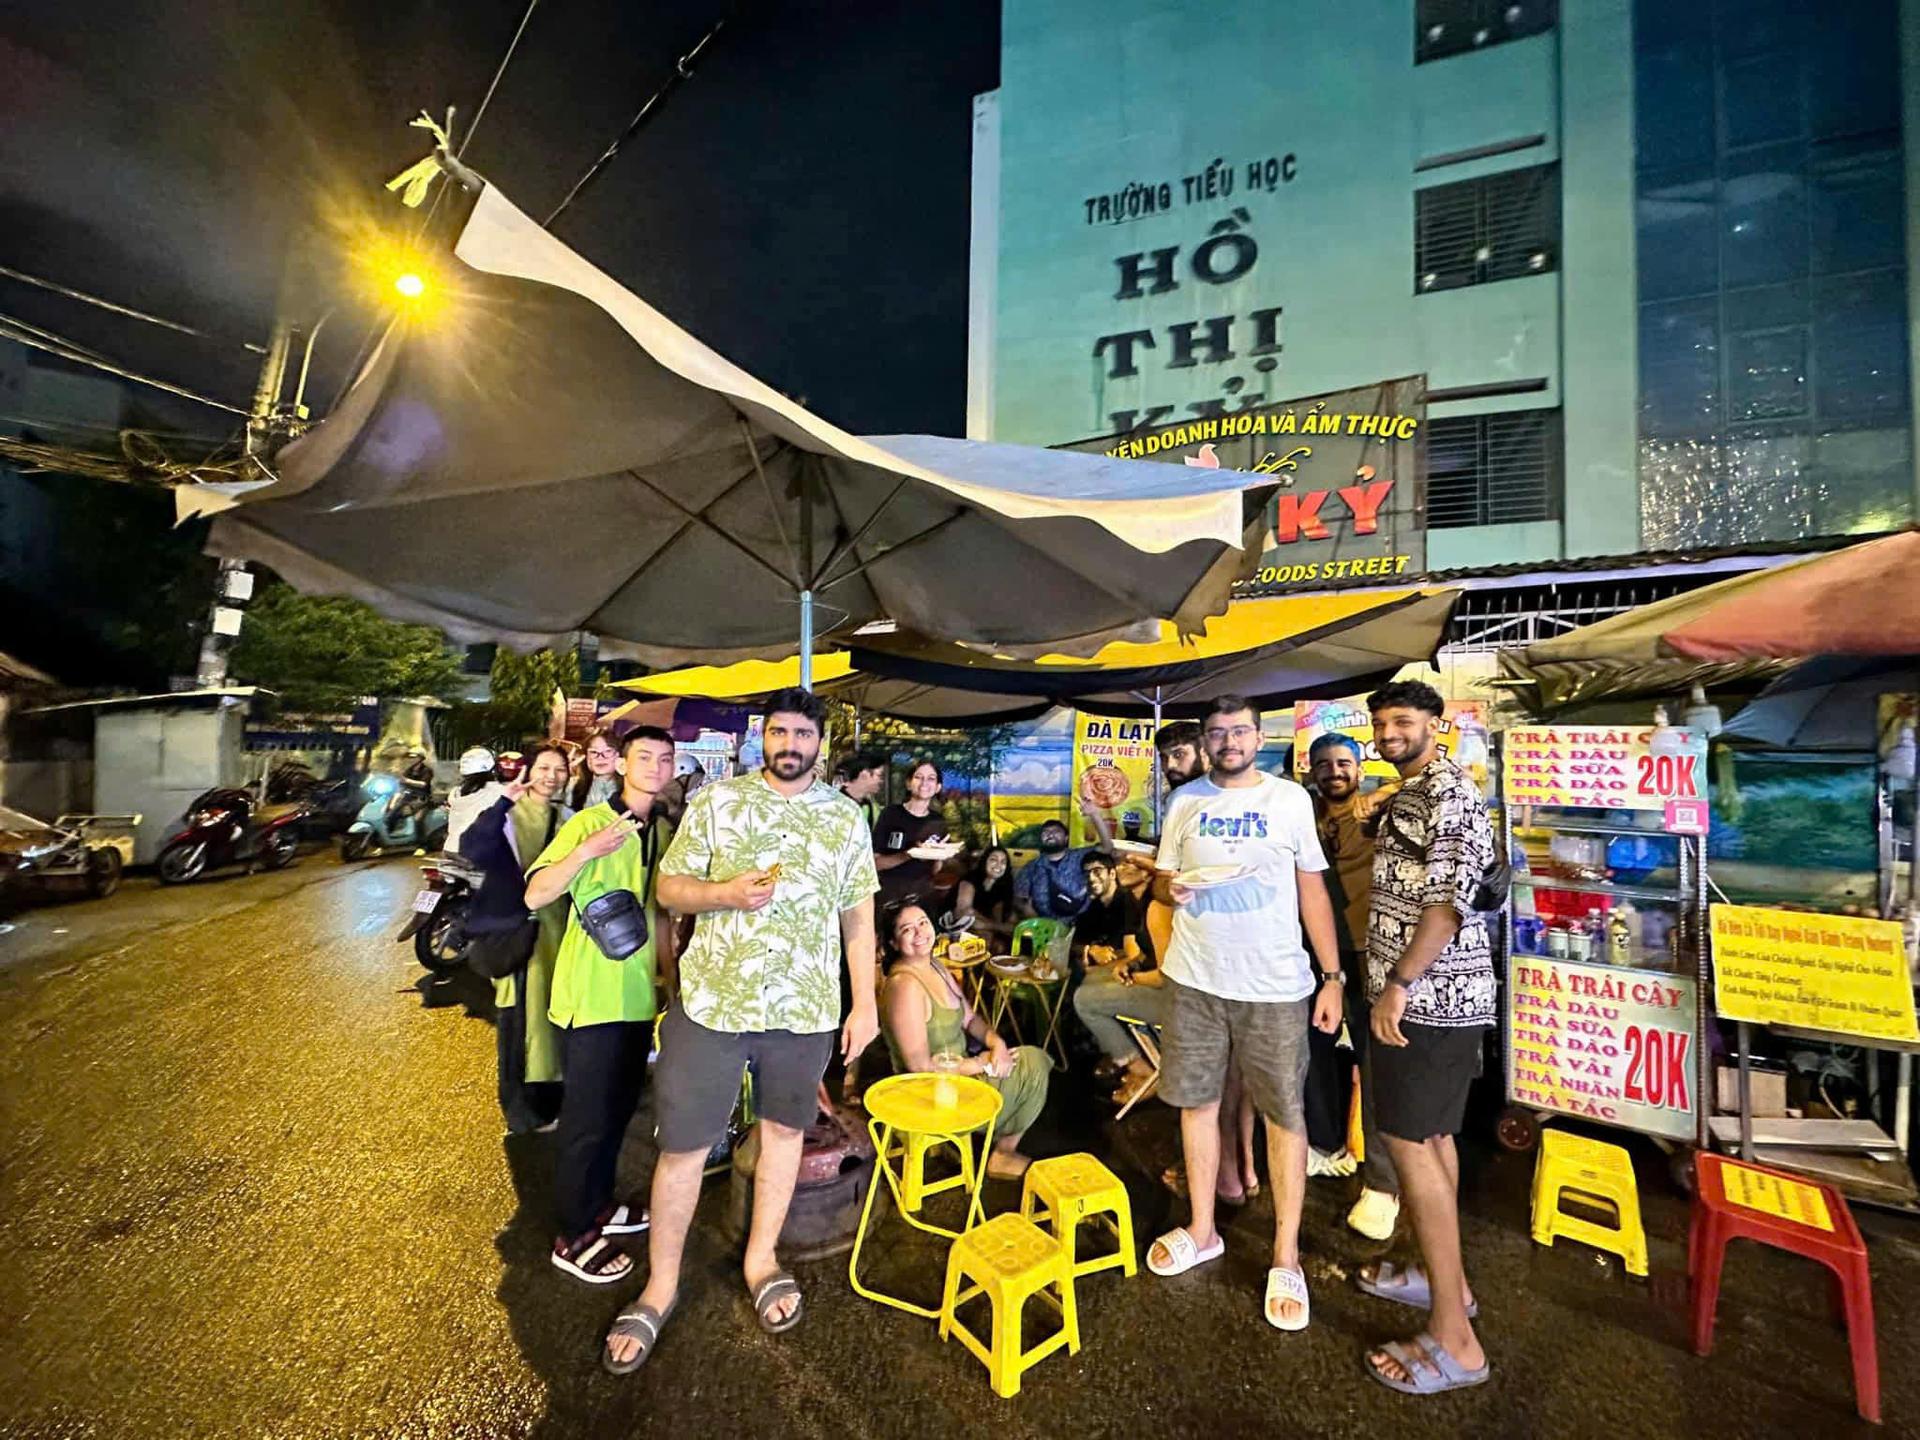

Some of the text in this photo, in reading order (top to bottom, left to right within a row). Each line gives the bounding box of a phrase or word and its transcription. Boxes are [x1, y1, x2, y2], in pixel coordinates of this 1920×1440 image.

[1084, 182, 1171, 225] TRƯỜNG
[1246, 152, 1297, 194] HỌC
[1113, 206, 1258, 300] HỒ
[1092, 307, 1283, 379] THỊ
[1146, 420, 1218, 455] DOANH
[1221, 415, 1266, 437] HOA
[1270, 408, 1296, 434] VÀ
[1300, 401, 1342, 435] ẨM
[1346, 414, 1417, 445] THỰC
[1278, 465, 1395, 543] KỶ
[1321, 555, 1411, 580] STREET
[1118, 723, 1155, 744] LẠT
[1511, 729, 1693, 744] TRÀ TRÁI CY
[1081, 744, 1114, 755] PIZZA
[1097, 758, 1114, 767] 20K
[1510, 747, 1562, 759] TRÀ
[1511, 762, 1624, 775] TRÀ SỮA
[1637, 755, 1697, 796] 20K
[1511, 776, 1563, 789] TRÀ
[1511, 792, 1626, 806] TRÀ TẮC
[1517, 966, 1684, 1008] TRÀ TRÁI CÂY
[1514, 993, 1619, 1020] TRÀ DÂU
[1514, 1010, 1616, 1039] TRÀ SỮA
[1514, 1028, 1561, 1047] TRÀ
[1514, 1048, 1560, 1067] TRÀ
[1624, 1025, 1690, 1111] 20K
[1514, 1067, 1621, 1100] TRÀ NHÃN
[1514, 1087, 1616, 1119] TRÀ TẮC
